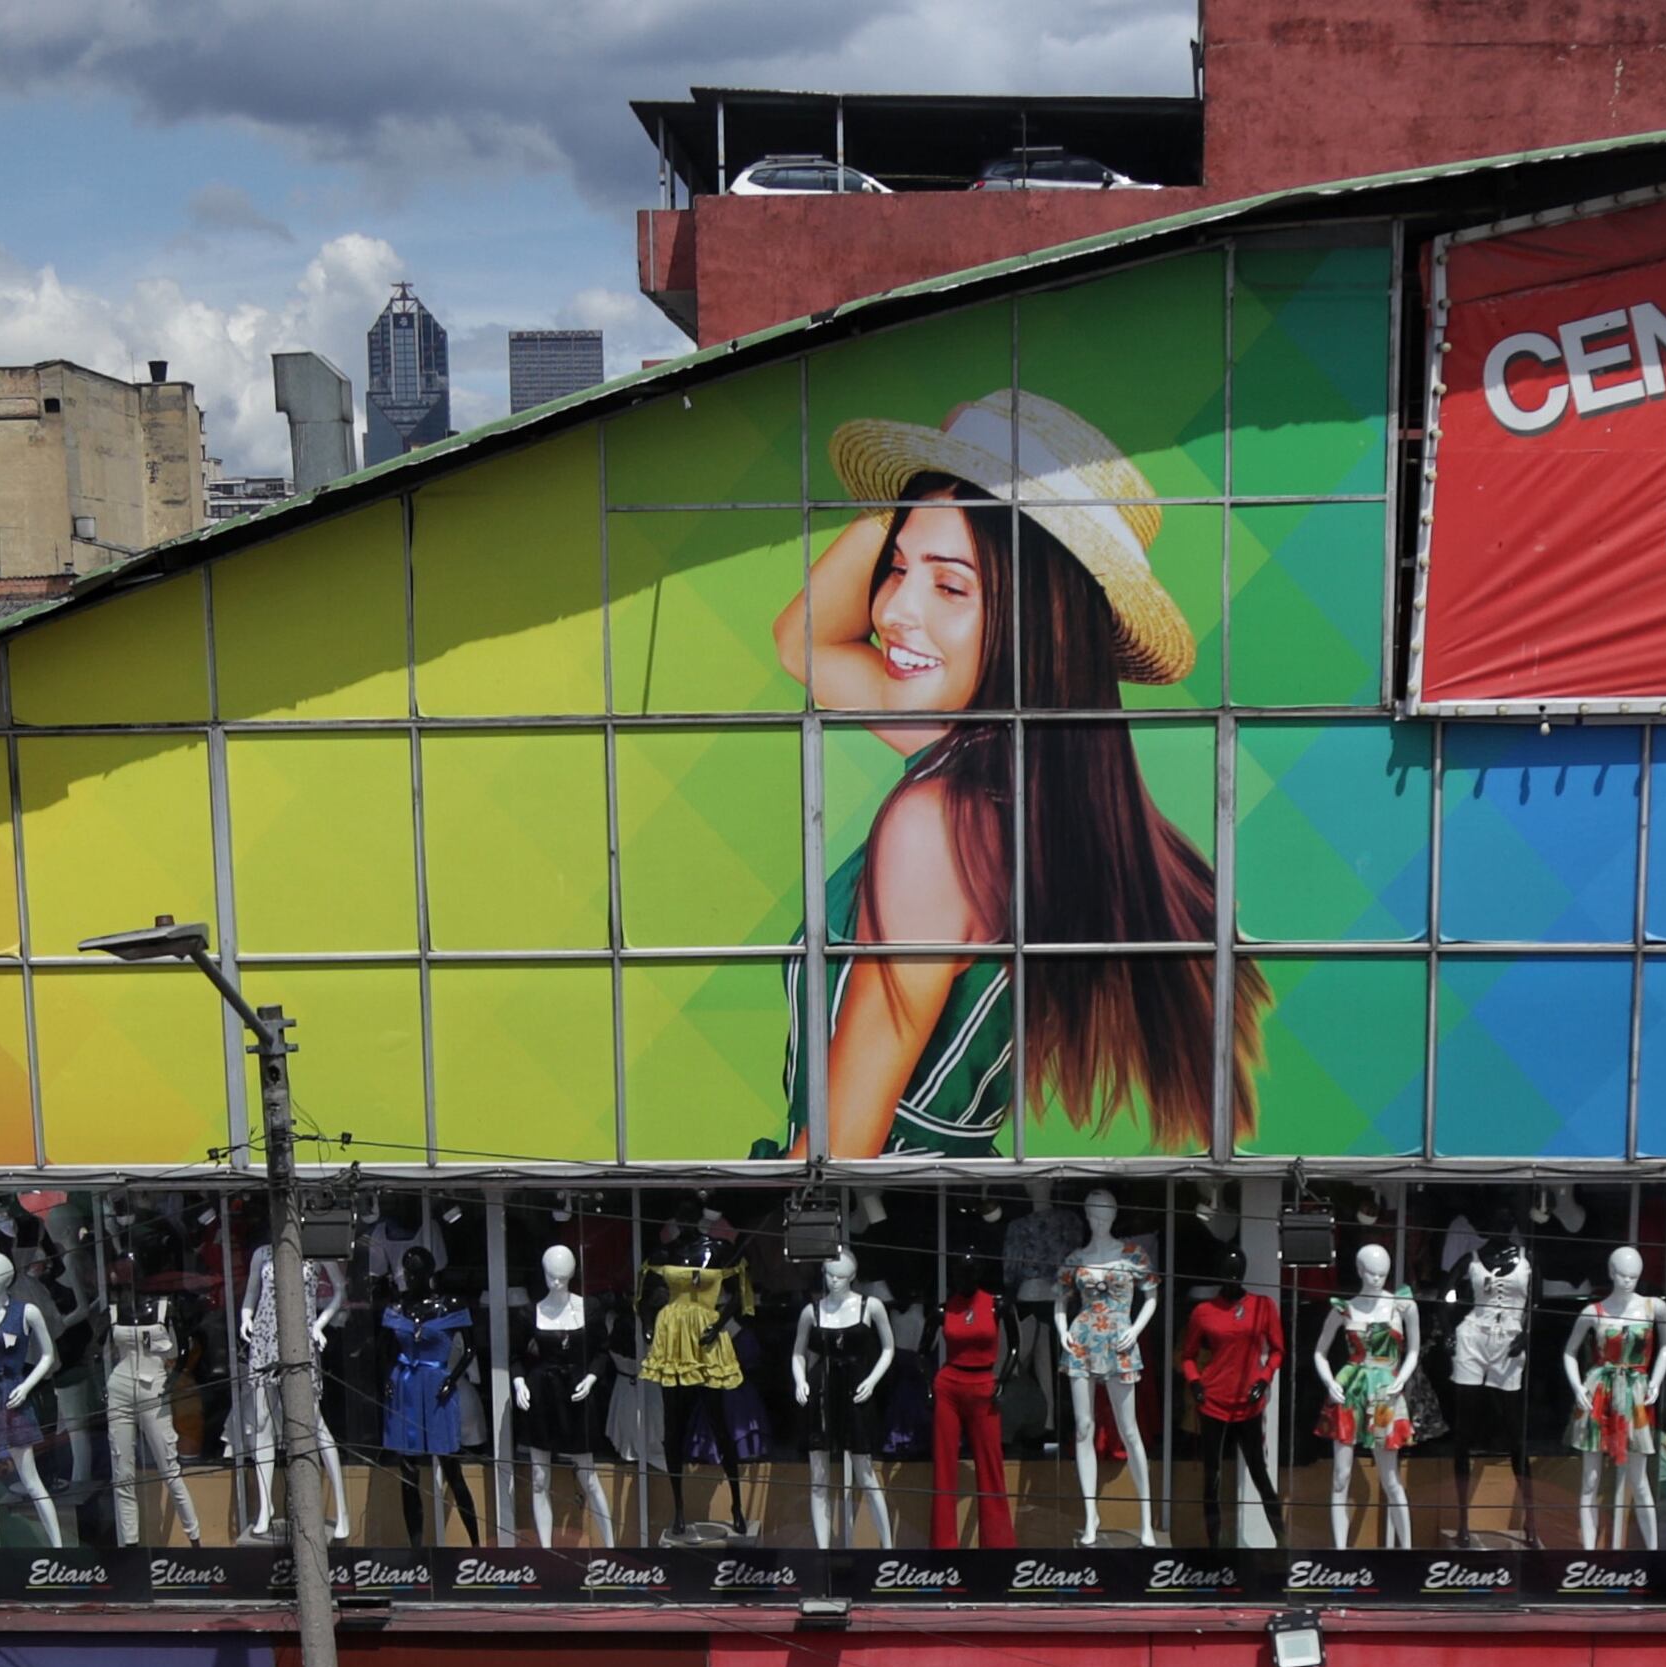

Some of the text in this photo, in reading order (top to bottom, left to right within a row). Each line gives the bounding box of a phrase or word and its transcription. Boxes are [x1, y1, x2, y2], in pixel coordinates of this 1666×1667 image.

[29, 1559, 108, 1584] Elian's
[151, 1559, 226, 1584] Elian's
[355, 1559, 430, 1584] Elian's
[456, 1559, 537, 1584] Elian's
[585, 1559, 666, 1584] Elian's
[714, 1561, 797, 1587] Elian's
[874, 1561, 962, 1587] Elian's
[1012, 1561, 1099, 1587] Elian's
[1149, 1561, 1237, 1587] Elian's
[1287, 1561, 1374, 1587] Elian's
[1425, 1561, 1513, 1587] Elian's
[1562, 1561, 1649, 1587] Elian's
